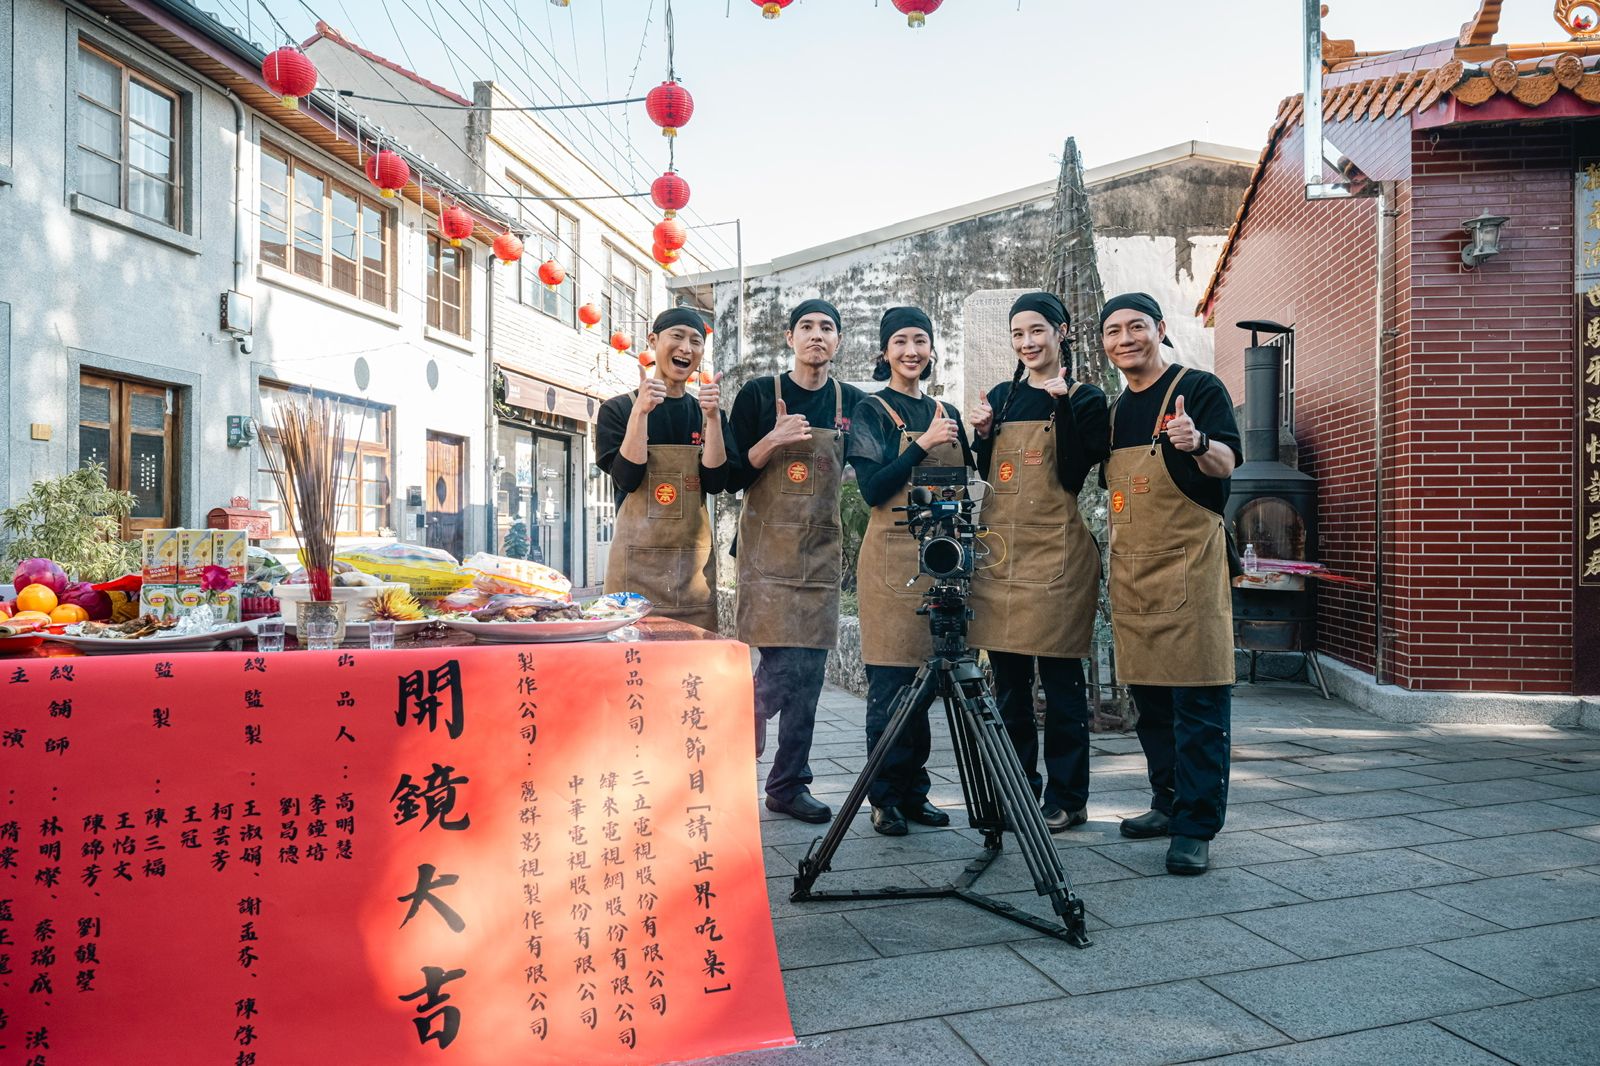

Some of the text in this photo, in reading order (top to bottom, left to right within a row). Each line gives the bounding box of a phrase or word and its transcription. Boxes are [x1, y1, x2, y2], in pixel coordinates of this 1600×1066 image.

[112, 812, 136, 881] 王怡文
[180, 805, 202, 849] 王冠
[210, 802, 234, 872] 柯芸芳
[278, 797, 300, 864] 劉昌德
[390, 660, 471, 1050] 開鏡大吉
[567, 775, 597, 1030] 中華電視股份有限公司
[599, 772, 636, 1050] 緯來電視網股份有限公司
